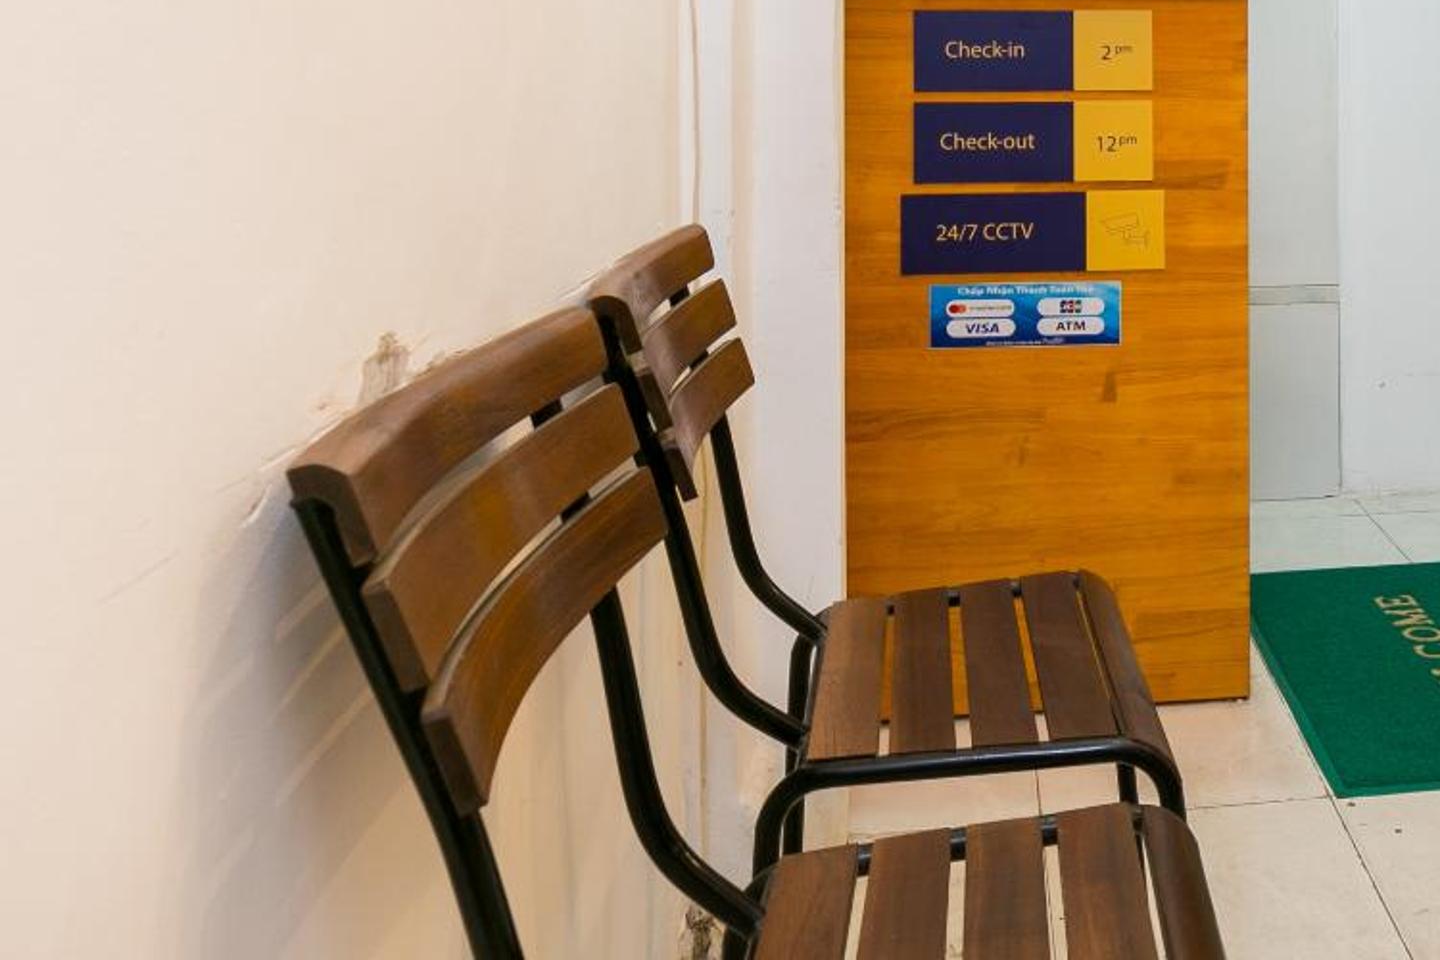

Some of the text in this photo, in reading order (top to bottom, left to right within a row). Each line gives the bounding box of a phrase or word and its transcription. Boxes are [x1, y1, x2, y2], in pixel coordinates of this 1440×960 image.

[945, 41, 1025, 58] Check-in
[940, 133, 1035, 151] Check-out
[936, 222, 1034, 242] 24/7 CCTV
[966, 322, 999, 334] VISA
[1056, 320, 1085, 331] ATM
